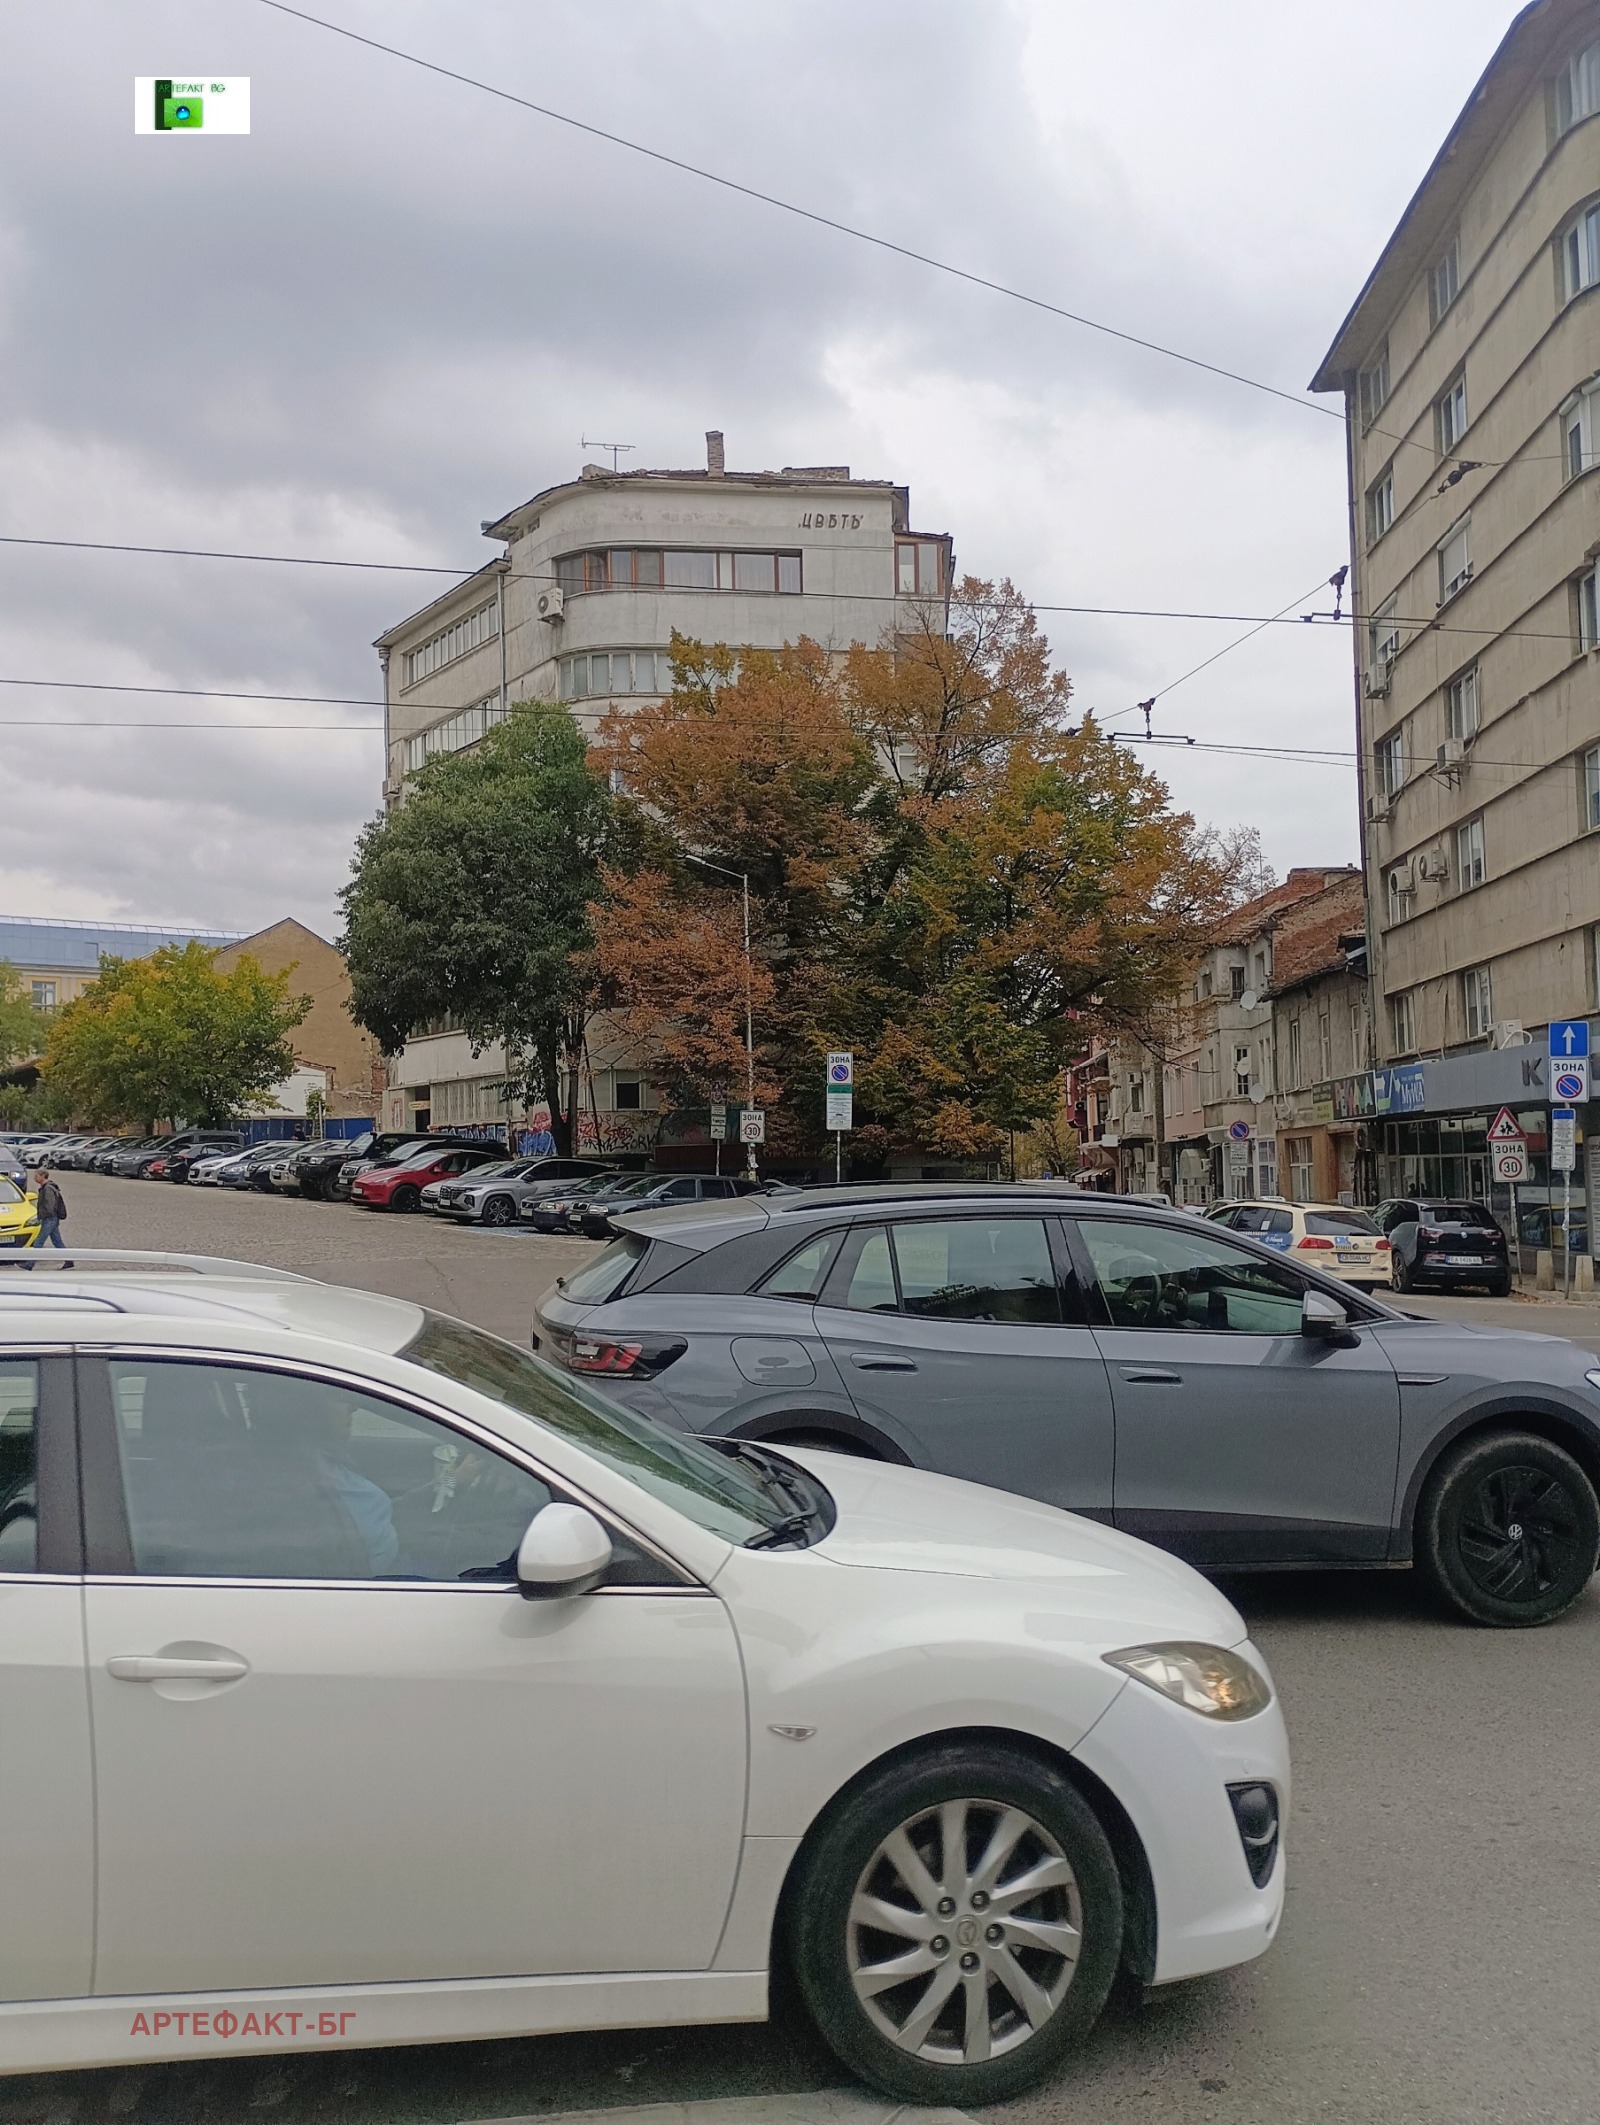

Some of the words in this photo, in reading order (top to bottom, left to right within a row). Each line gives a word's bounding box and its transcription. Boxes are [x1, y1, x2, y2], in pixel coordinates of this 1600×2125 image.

[829, 1056, 850, 1064] ЗОНА
[1553, 1063, 1585, 1072] ЗОНА
[747, 1127, 758, 1136] 30
[1495, 1145, 1524, 1154] ЗОНА
[1503, 1161, 1518, 1173] 30
